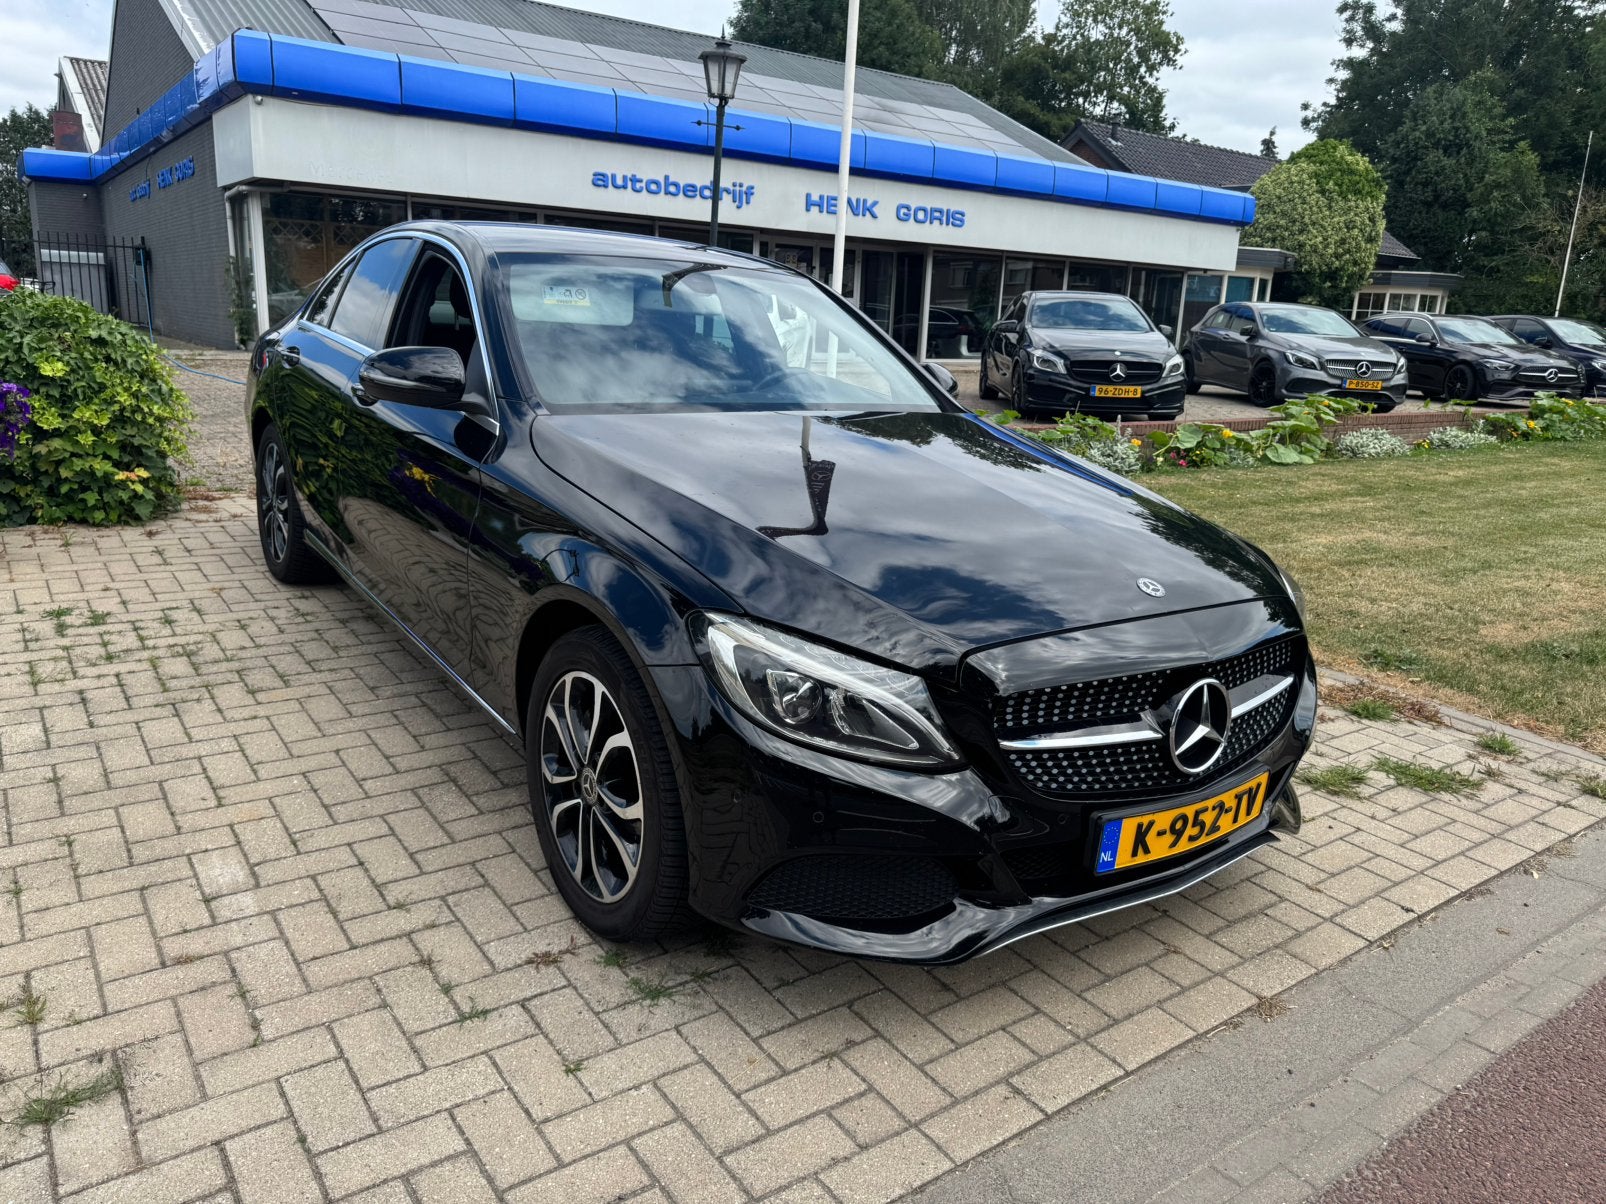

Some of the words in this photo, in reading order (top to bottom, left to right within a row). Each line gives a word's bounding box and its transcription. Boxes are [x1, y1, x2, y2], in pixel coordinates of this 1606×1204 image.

[592, 171, 755, 209] autobedrijf
[805, 192, 880, 219] HENK
[896, 203, 966, 228] GORIS
[1097, 386, 1138, 396] 96-ZDH-8
[1099, 850, 1114, 863] NL
[1131, 781, 1262, 858] K-952-TV
